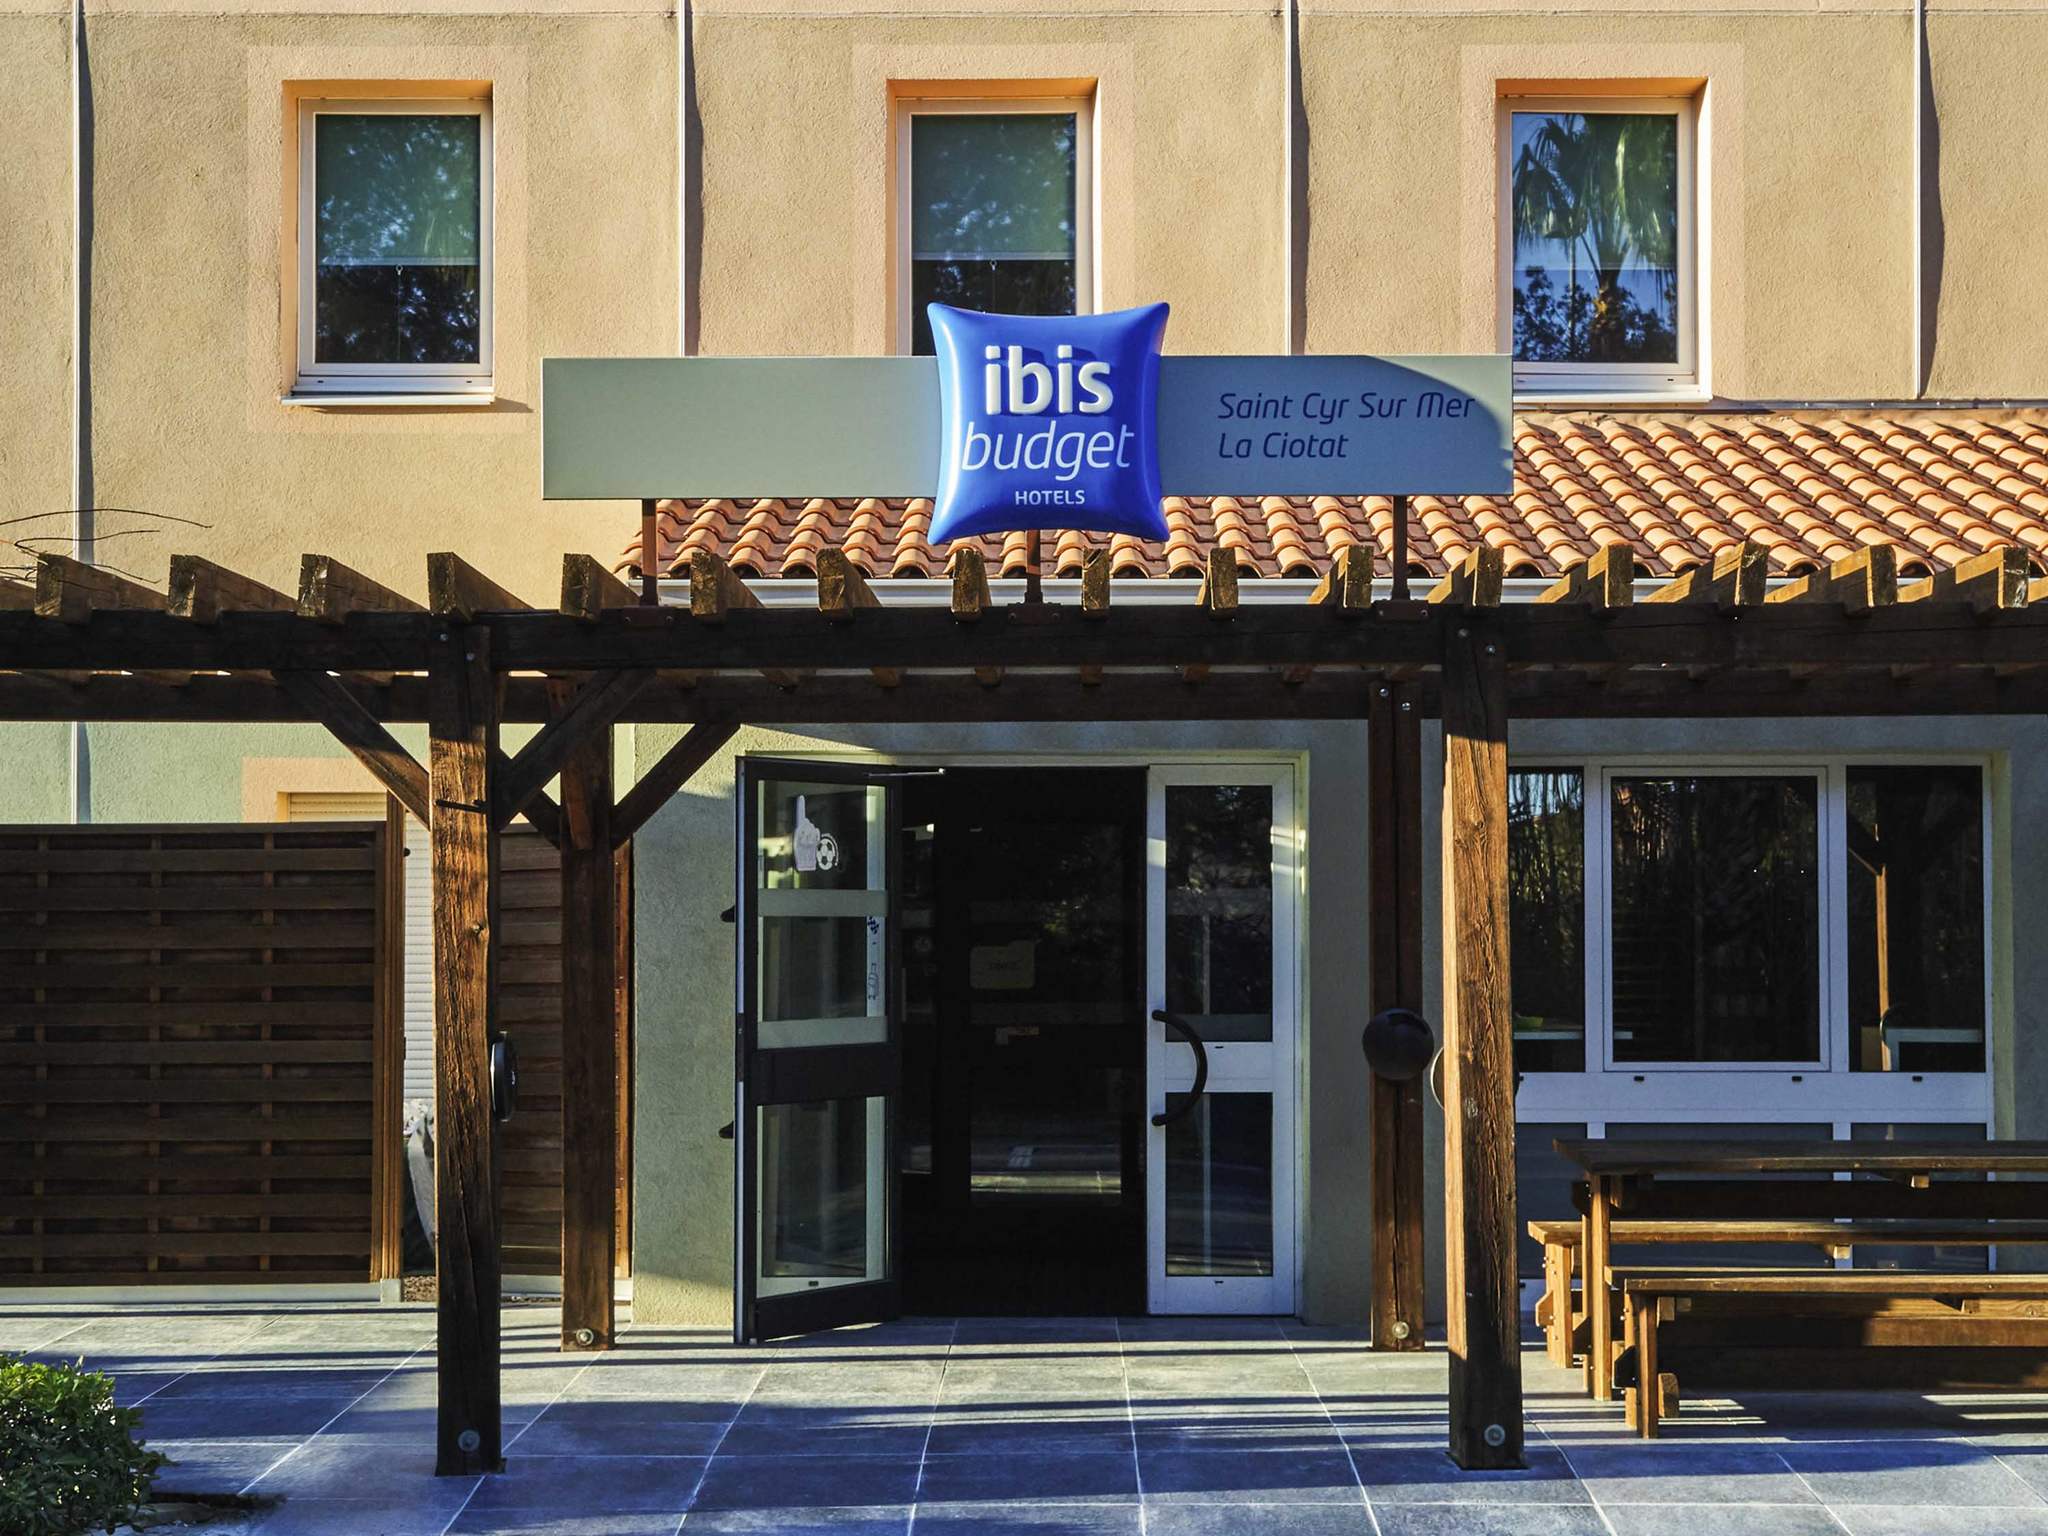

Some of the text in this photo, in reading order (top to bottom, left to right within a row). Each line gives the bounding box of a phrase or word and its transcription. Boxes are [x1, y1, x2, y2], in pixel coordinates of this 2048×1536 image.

[985, 344, 1114, 415] ibis
[1218, 392, 1475, 425] Saint Cyr Sur Mer
[961, 420, 1135, 481] budget
[1218, 432, 1349, 458] La Ciotat
[1015, 490, 1085, 505] HOTELS
